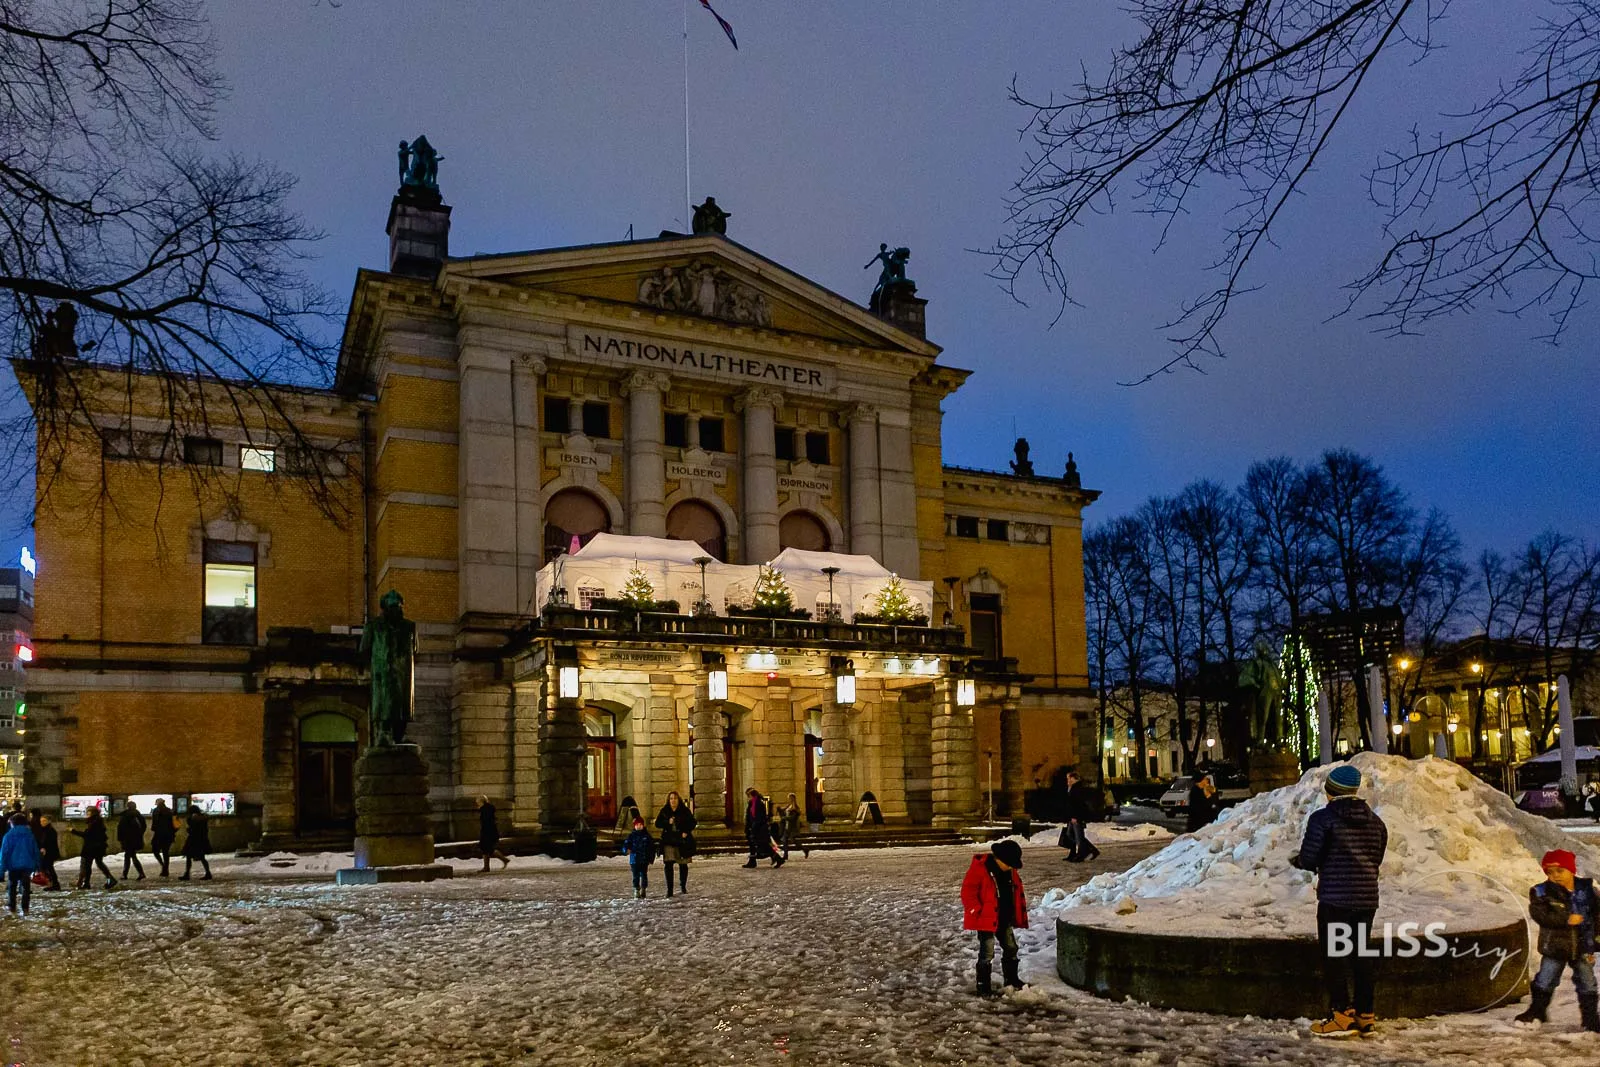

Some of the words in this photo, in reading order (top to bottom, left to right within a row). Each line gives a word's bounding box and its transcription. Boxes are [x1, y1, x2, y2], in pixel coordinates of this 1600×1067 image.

[584, 334, 822, 386] NATIONALTHEATER
[560, 453, 598, 465] IBSEN
[671, 465, 722, 479] HOLBERG
[780, 477, 829, 491] BJØRNSON
